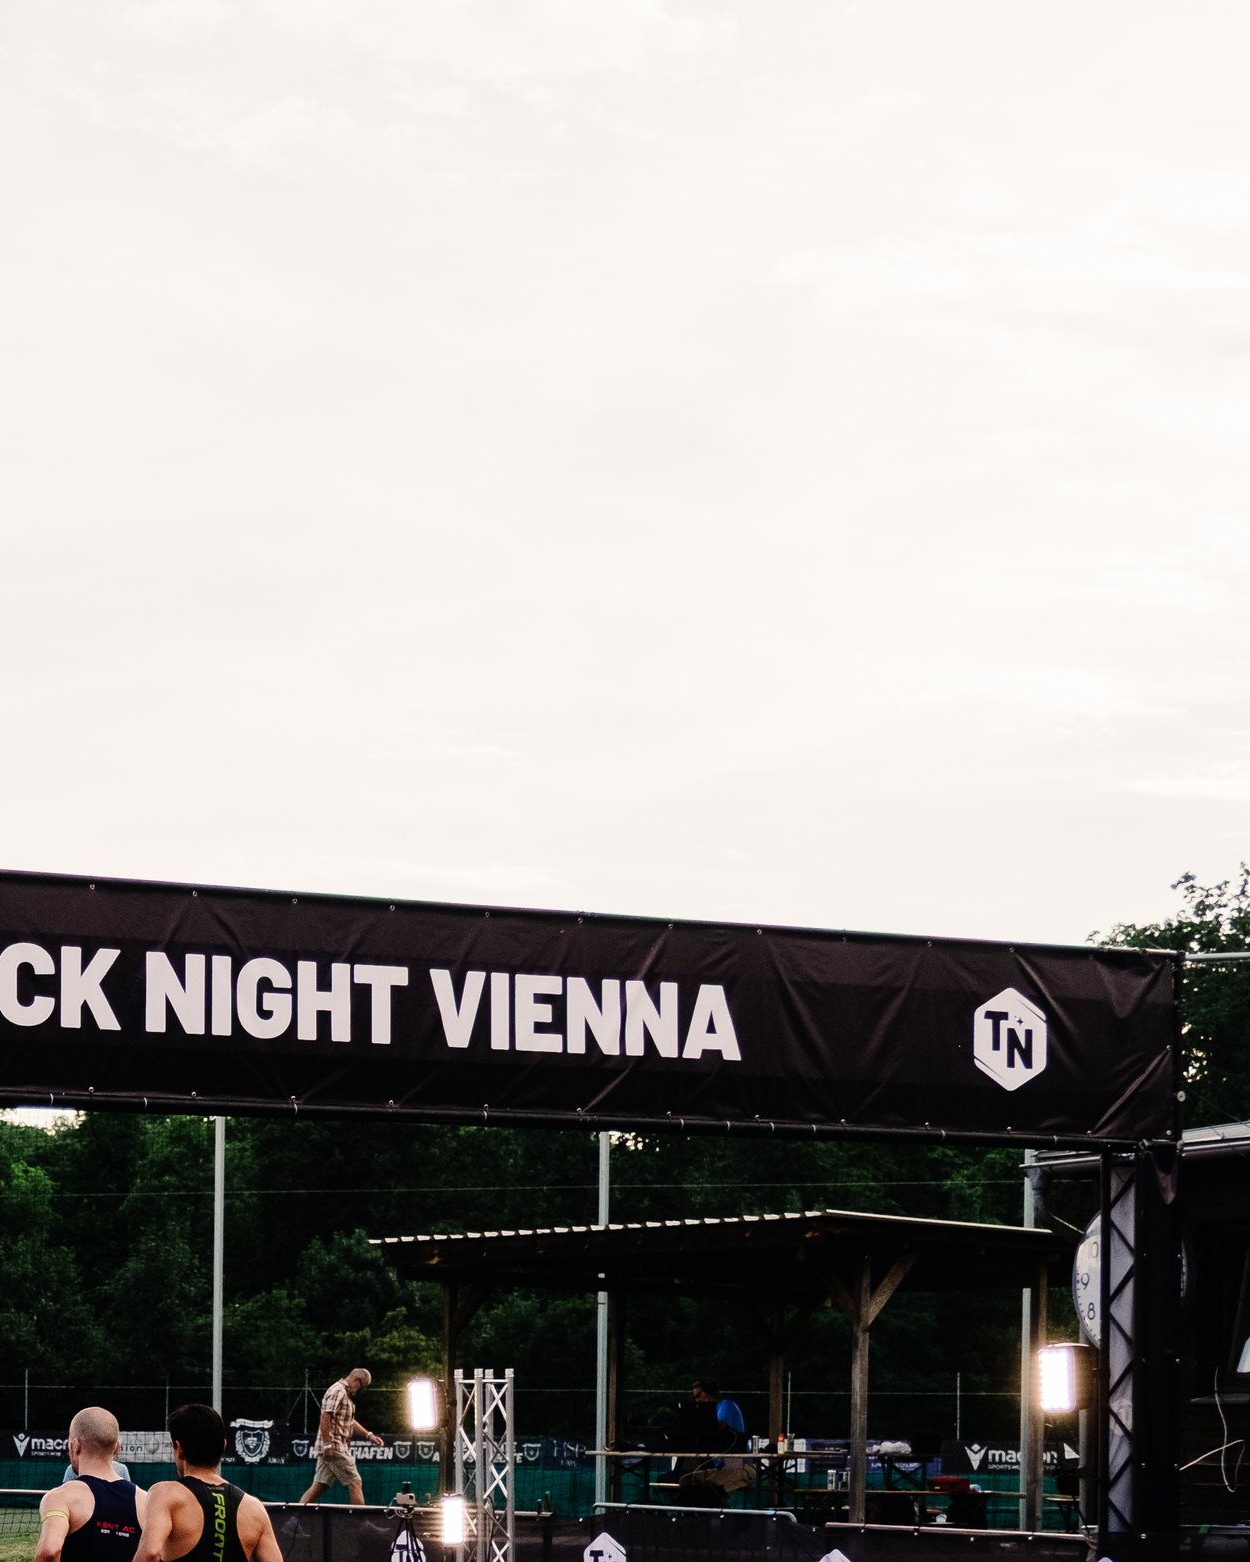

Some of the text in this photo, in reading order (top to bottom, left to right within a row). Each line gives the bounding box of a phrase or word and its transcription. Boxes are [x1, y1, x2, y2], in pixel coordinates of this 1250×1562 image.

[145, 950, 409, 1045] NIGHT
[429, 968, 742, 1062] VIENNA
[984, 1011, 1032, 1069] TN
[1080, 1272, 1090, 1290] 9
[1087, 1302, 1096, 1320] 8
[31, 1438, 70, 1450] macr
[96, 1521, 136, 1534] KENT AC
[212, 1491, 227, 1562] FRONT
